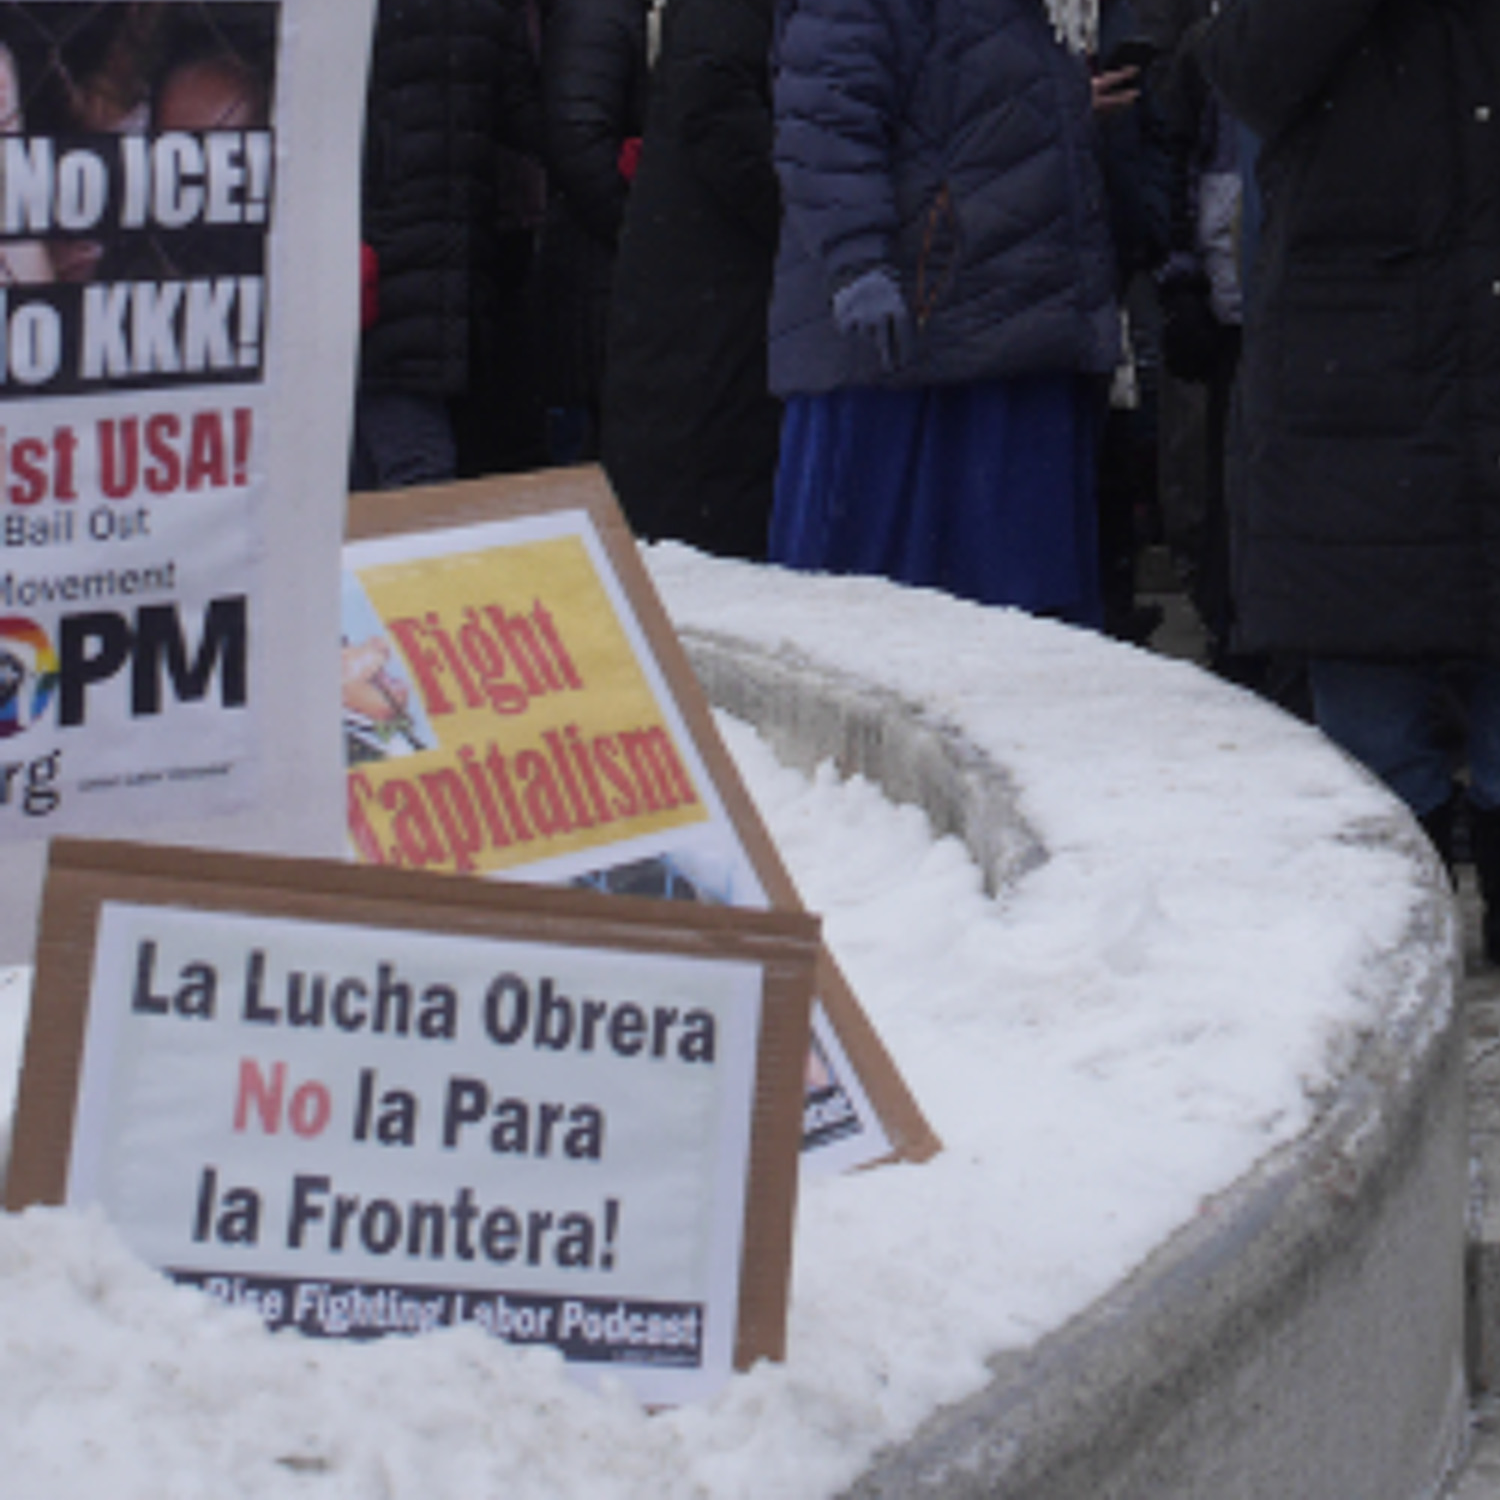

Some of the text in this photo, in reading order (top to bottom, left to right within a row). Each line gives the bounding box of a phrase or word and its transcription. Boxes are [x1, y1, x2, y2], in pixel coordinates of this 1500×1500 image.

[0, 130, 272, 233] No ICE!
[79, 275, 263, 380] KKK!
[0, 406, 253, 506] st USA!
[4, 505, 151, 547] Bail Out
[388, 596, 583, 716] Fight
[348, 723, 698, 874] Capitalism
[131, 938, 717, 1065] La Lucha Obrera
[233, 1056, 606, 1161] No la Para
[192, 1163, 622, 1272] la Frontera!
[295, 1282, 446, 1335] Fighting
[558, 1300, 698, 1347] Podcast
